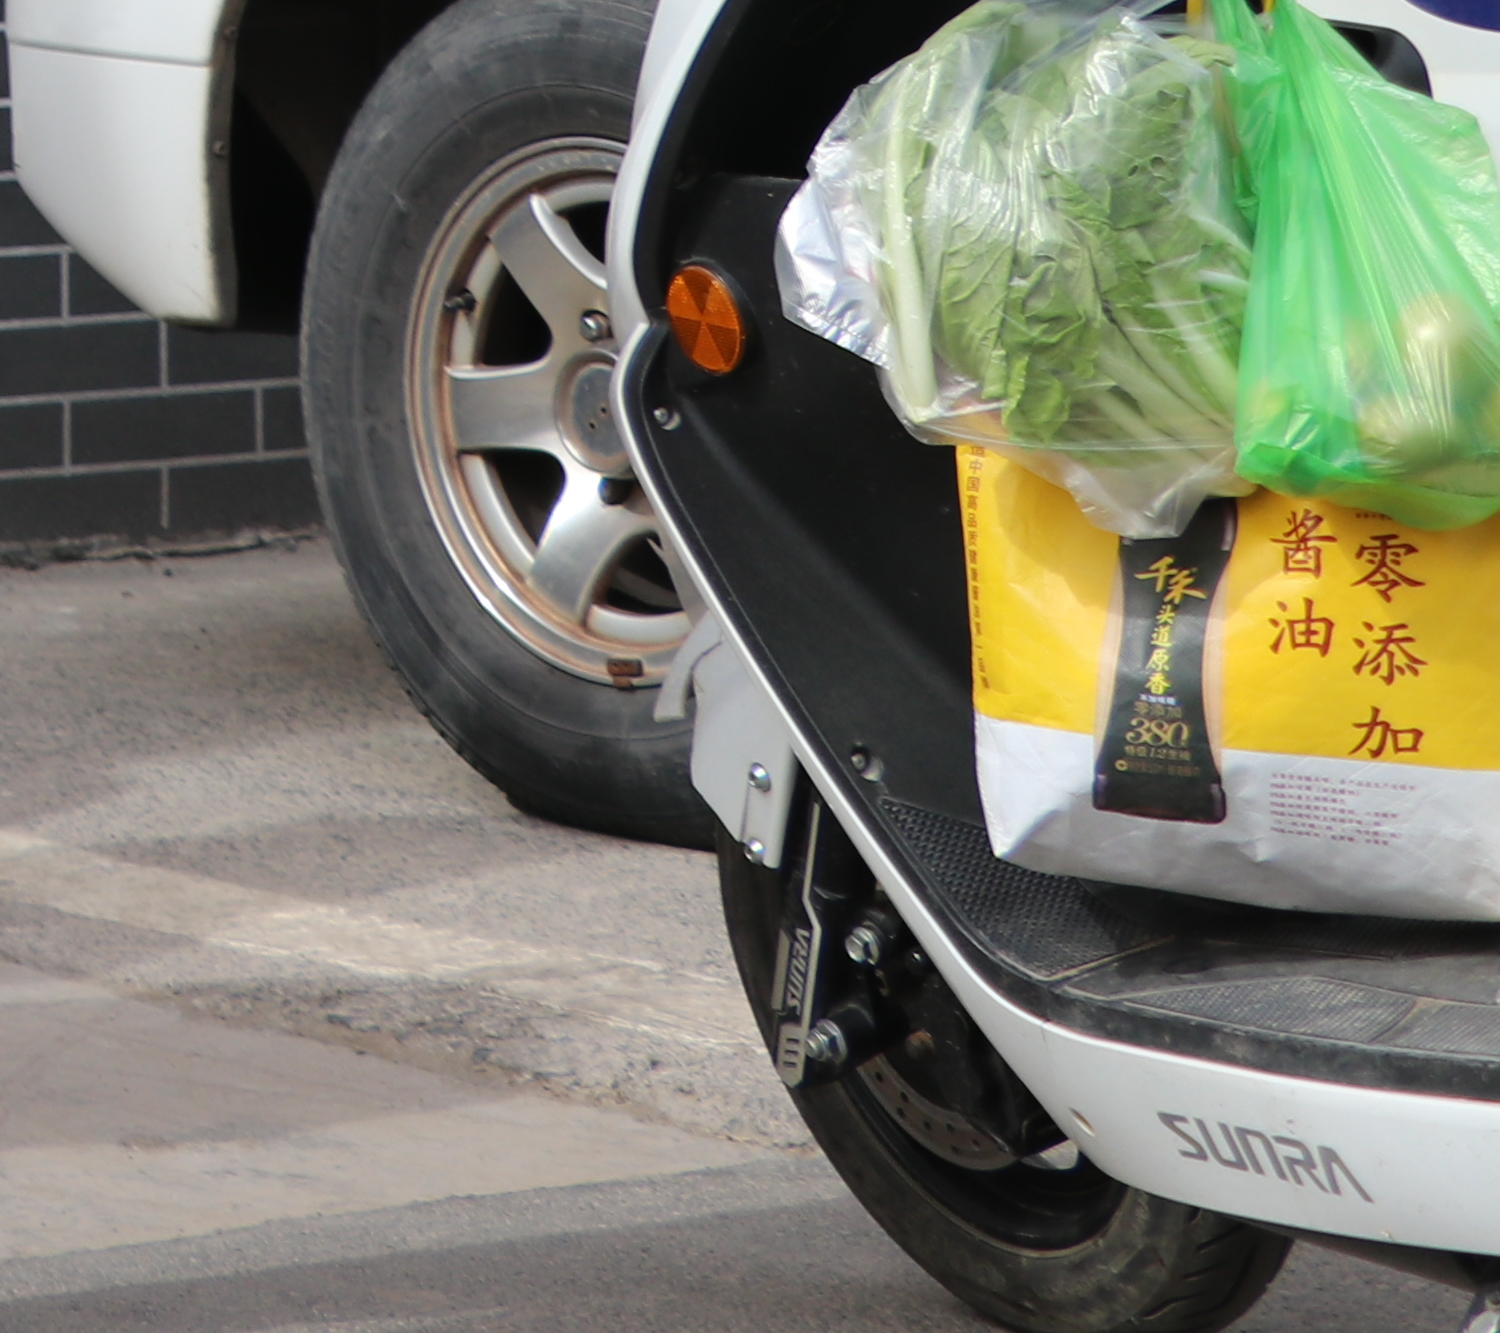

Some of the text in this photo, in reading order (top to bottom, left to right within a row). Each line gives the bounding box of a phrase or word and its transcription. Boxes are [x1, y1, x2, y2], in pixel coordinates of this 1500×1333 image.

[1269, 508, 1339, 659] 酱油
[1348, 534, 1429, 759] 零添加
[1156, 1110, 1375, 1205] SUNRA
